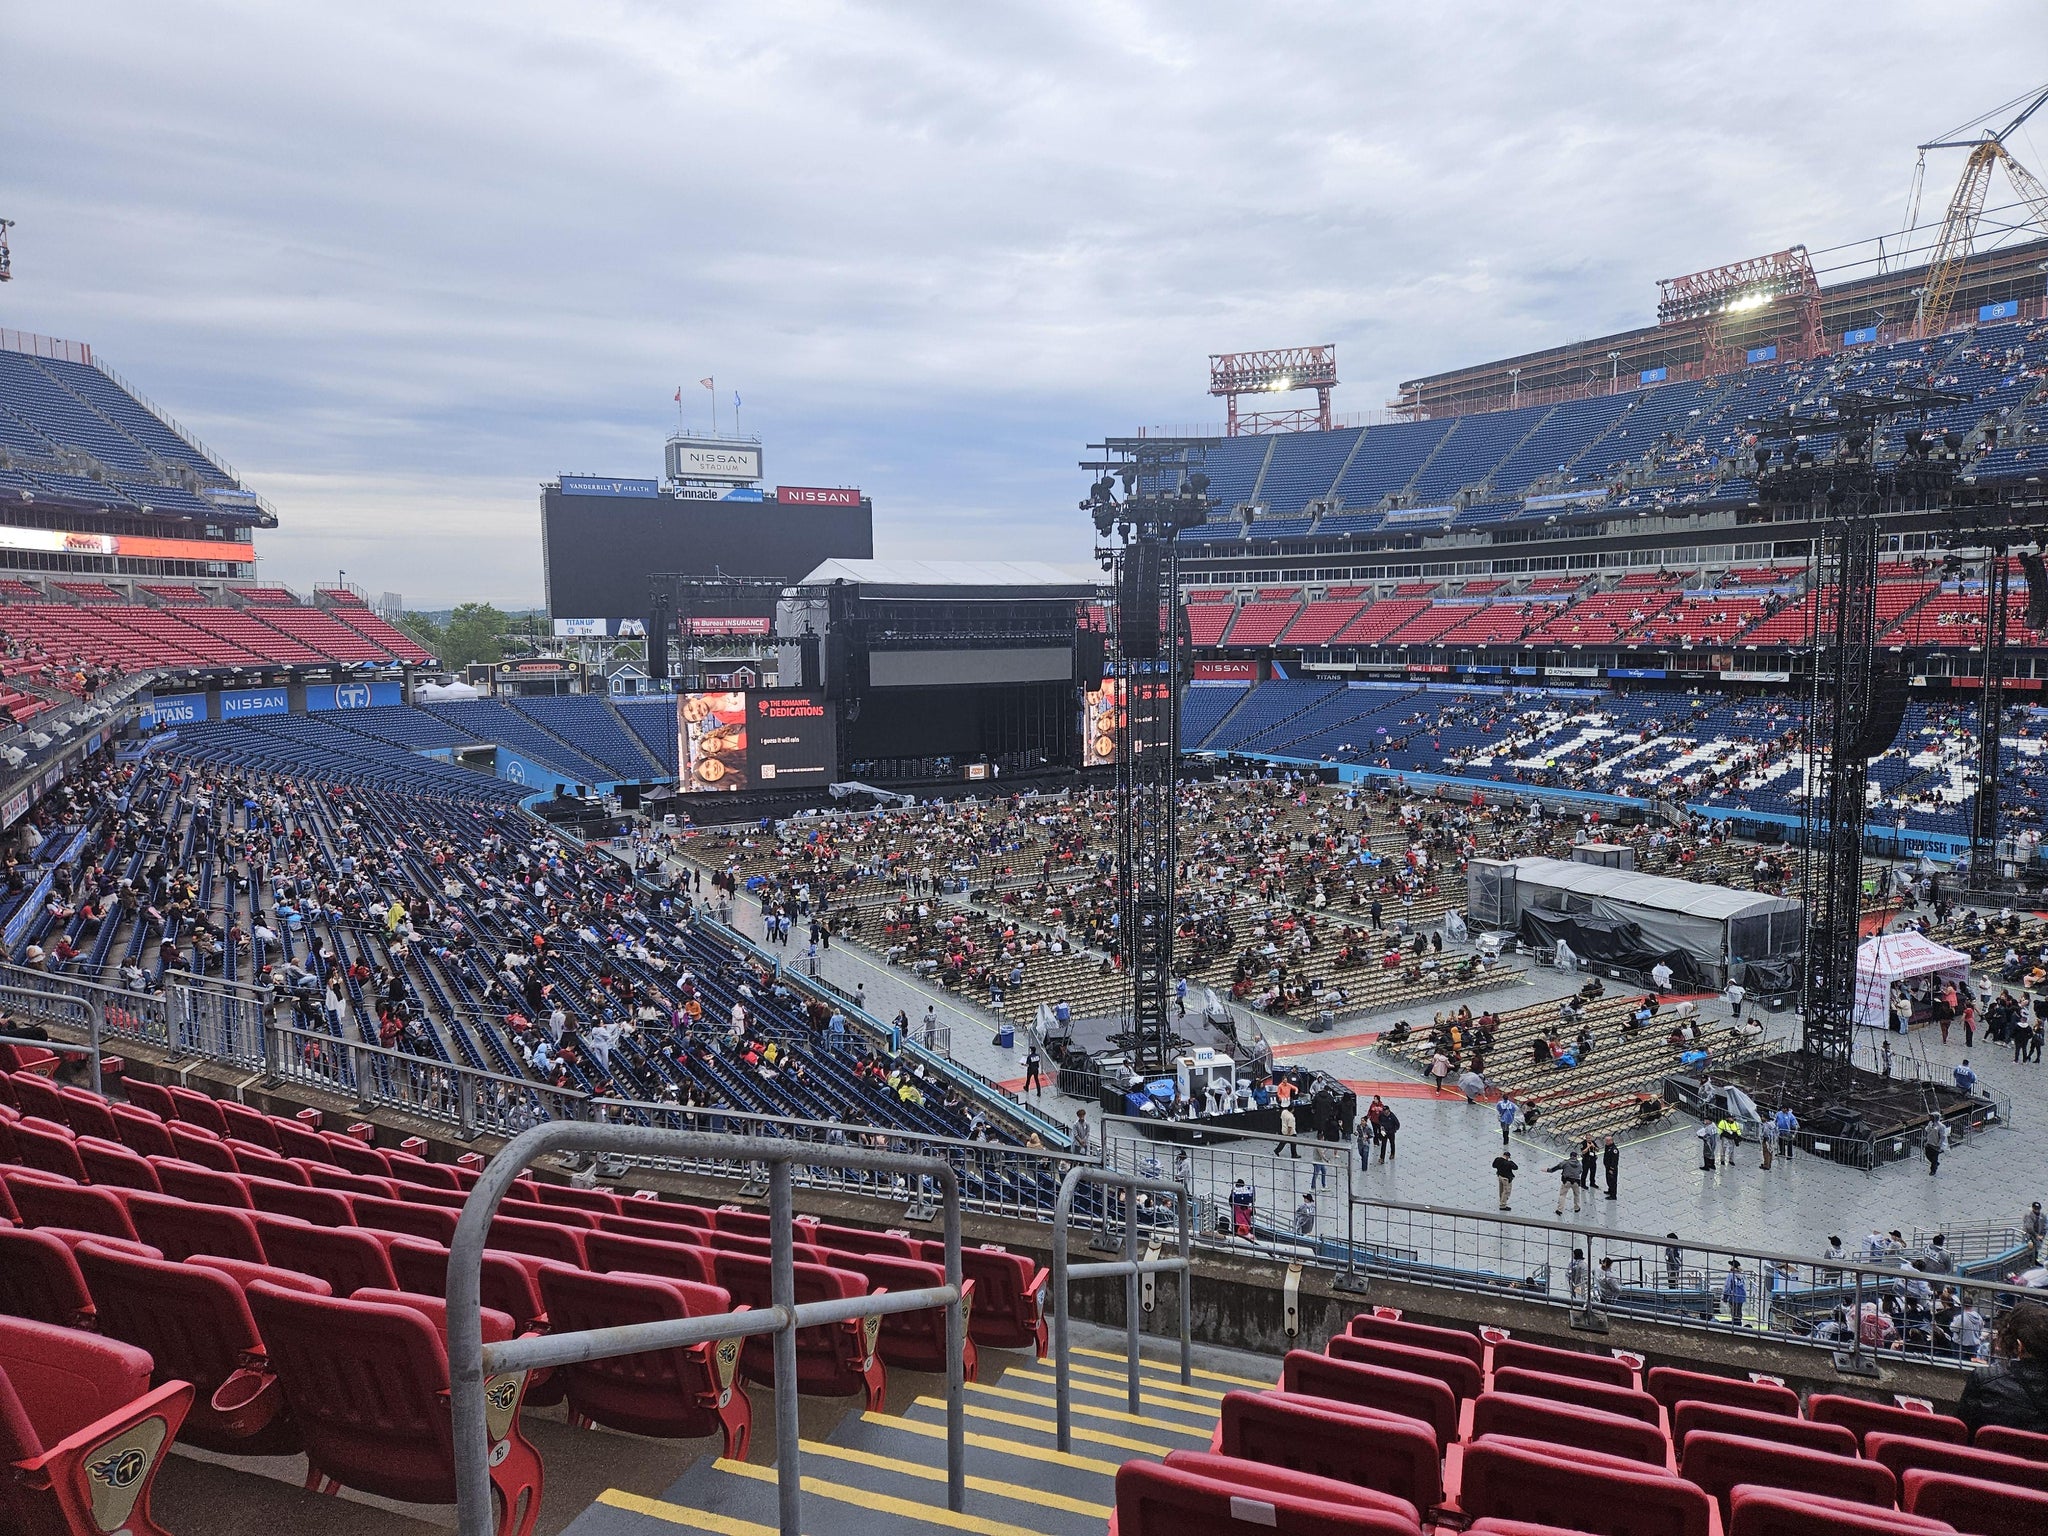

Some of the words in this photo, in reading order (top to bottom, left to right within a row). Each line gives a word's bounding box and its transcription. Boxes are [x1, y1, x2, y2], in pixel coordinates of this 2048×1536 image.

[690, 453, 748, 464] NISSAN
[700, 463, 739, 471] STADIUM
[569, 483, 612, 491] VANDERBILT
[676, 488, 718, 500] Pinnacle
[788, 491, 850, 503] NISSAN
[725, 619, 765, 627] INSURANCE
[1202, 664, 1249, 672] NISSAN
[155, 700, 185, 709] TENNESSEE
[225, 696, 284, 711] NISSAN
[781, 699, 811, 707] ROMANTIC
[152, 705, 194, 724] TITANS
[769, 706, 824, 718] DEDICATIONS
[1315, 982, 1320, 990] J
[995, 994, 1001, 1002] K
[495, 1446, 504, 1461] E
